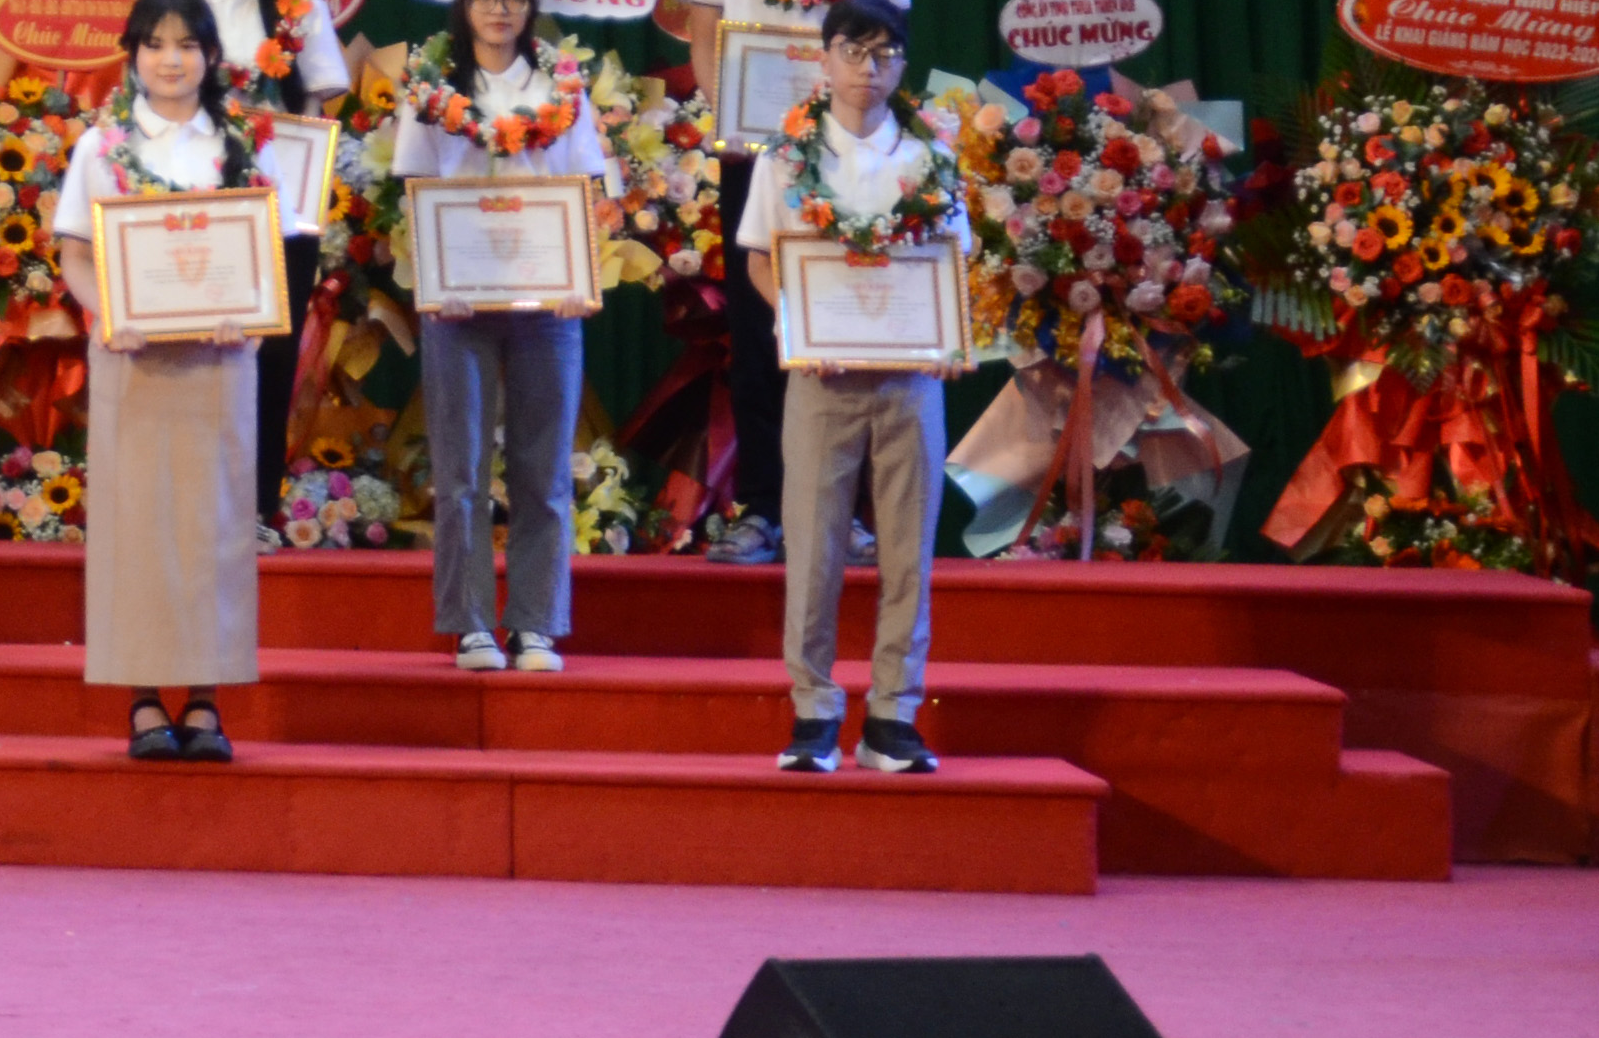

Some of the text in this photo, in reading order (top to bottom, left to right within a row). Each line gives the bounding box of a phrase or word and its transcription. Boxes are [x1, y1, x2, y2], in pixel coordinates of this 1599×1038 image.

[13, 20, 61, 46] Chúc
[1008, 16, 1154, 50] CHÚC MỪNG
[1483, 9, 1596, 42] Mừng
